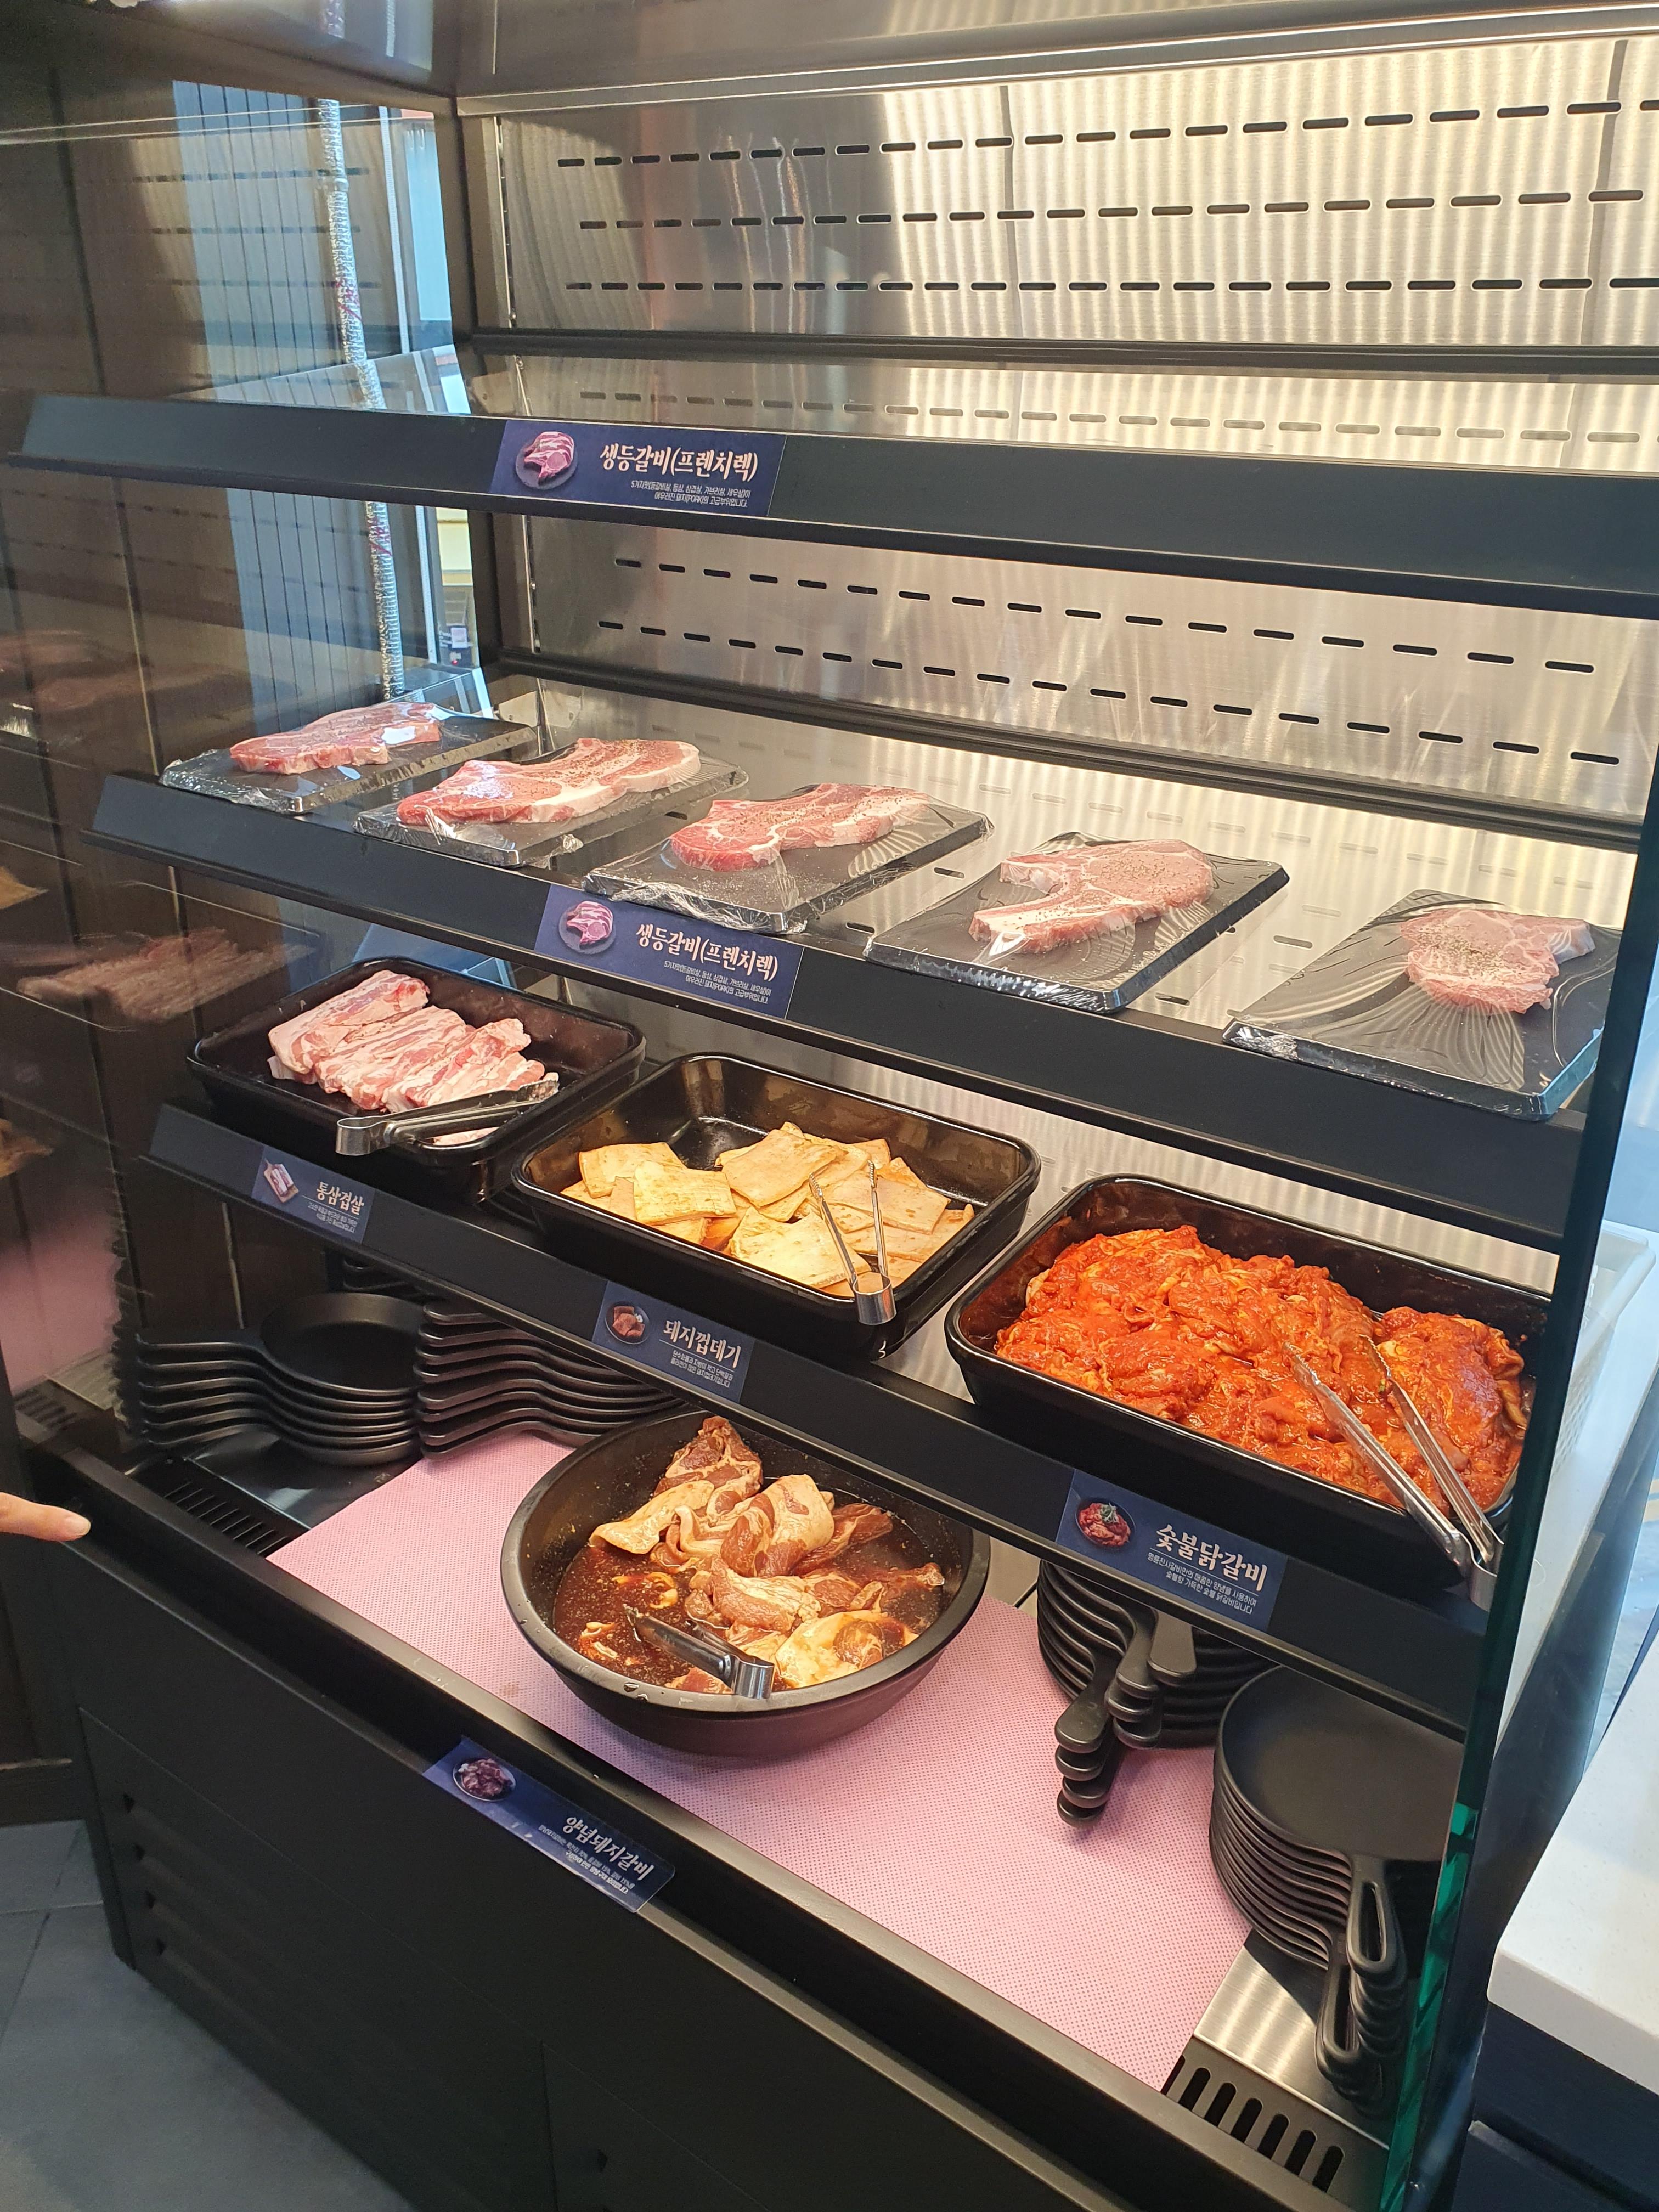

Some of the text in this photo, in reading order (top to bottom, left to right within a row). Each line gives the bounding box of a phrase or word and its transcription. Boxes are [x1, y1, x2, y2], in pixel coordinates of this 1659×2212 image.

[600, 443, 758, 482] 생등갈비(프렌치렉)
[636, 923, 778, 981] 생등갈비(프렌치렉)
[317, 1181, 364, 1215] 통삼겹살
[663, 1320, 741, 1368] 돼지껍데기
[1156, 1524, 1267, 1592] 숯불닭갈비
[1232, 1589, 1256, 1606] 사용하여
[562, 1817, 654, 1881] 양념돼지갈비
